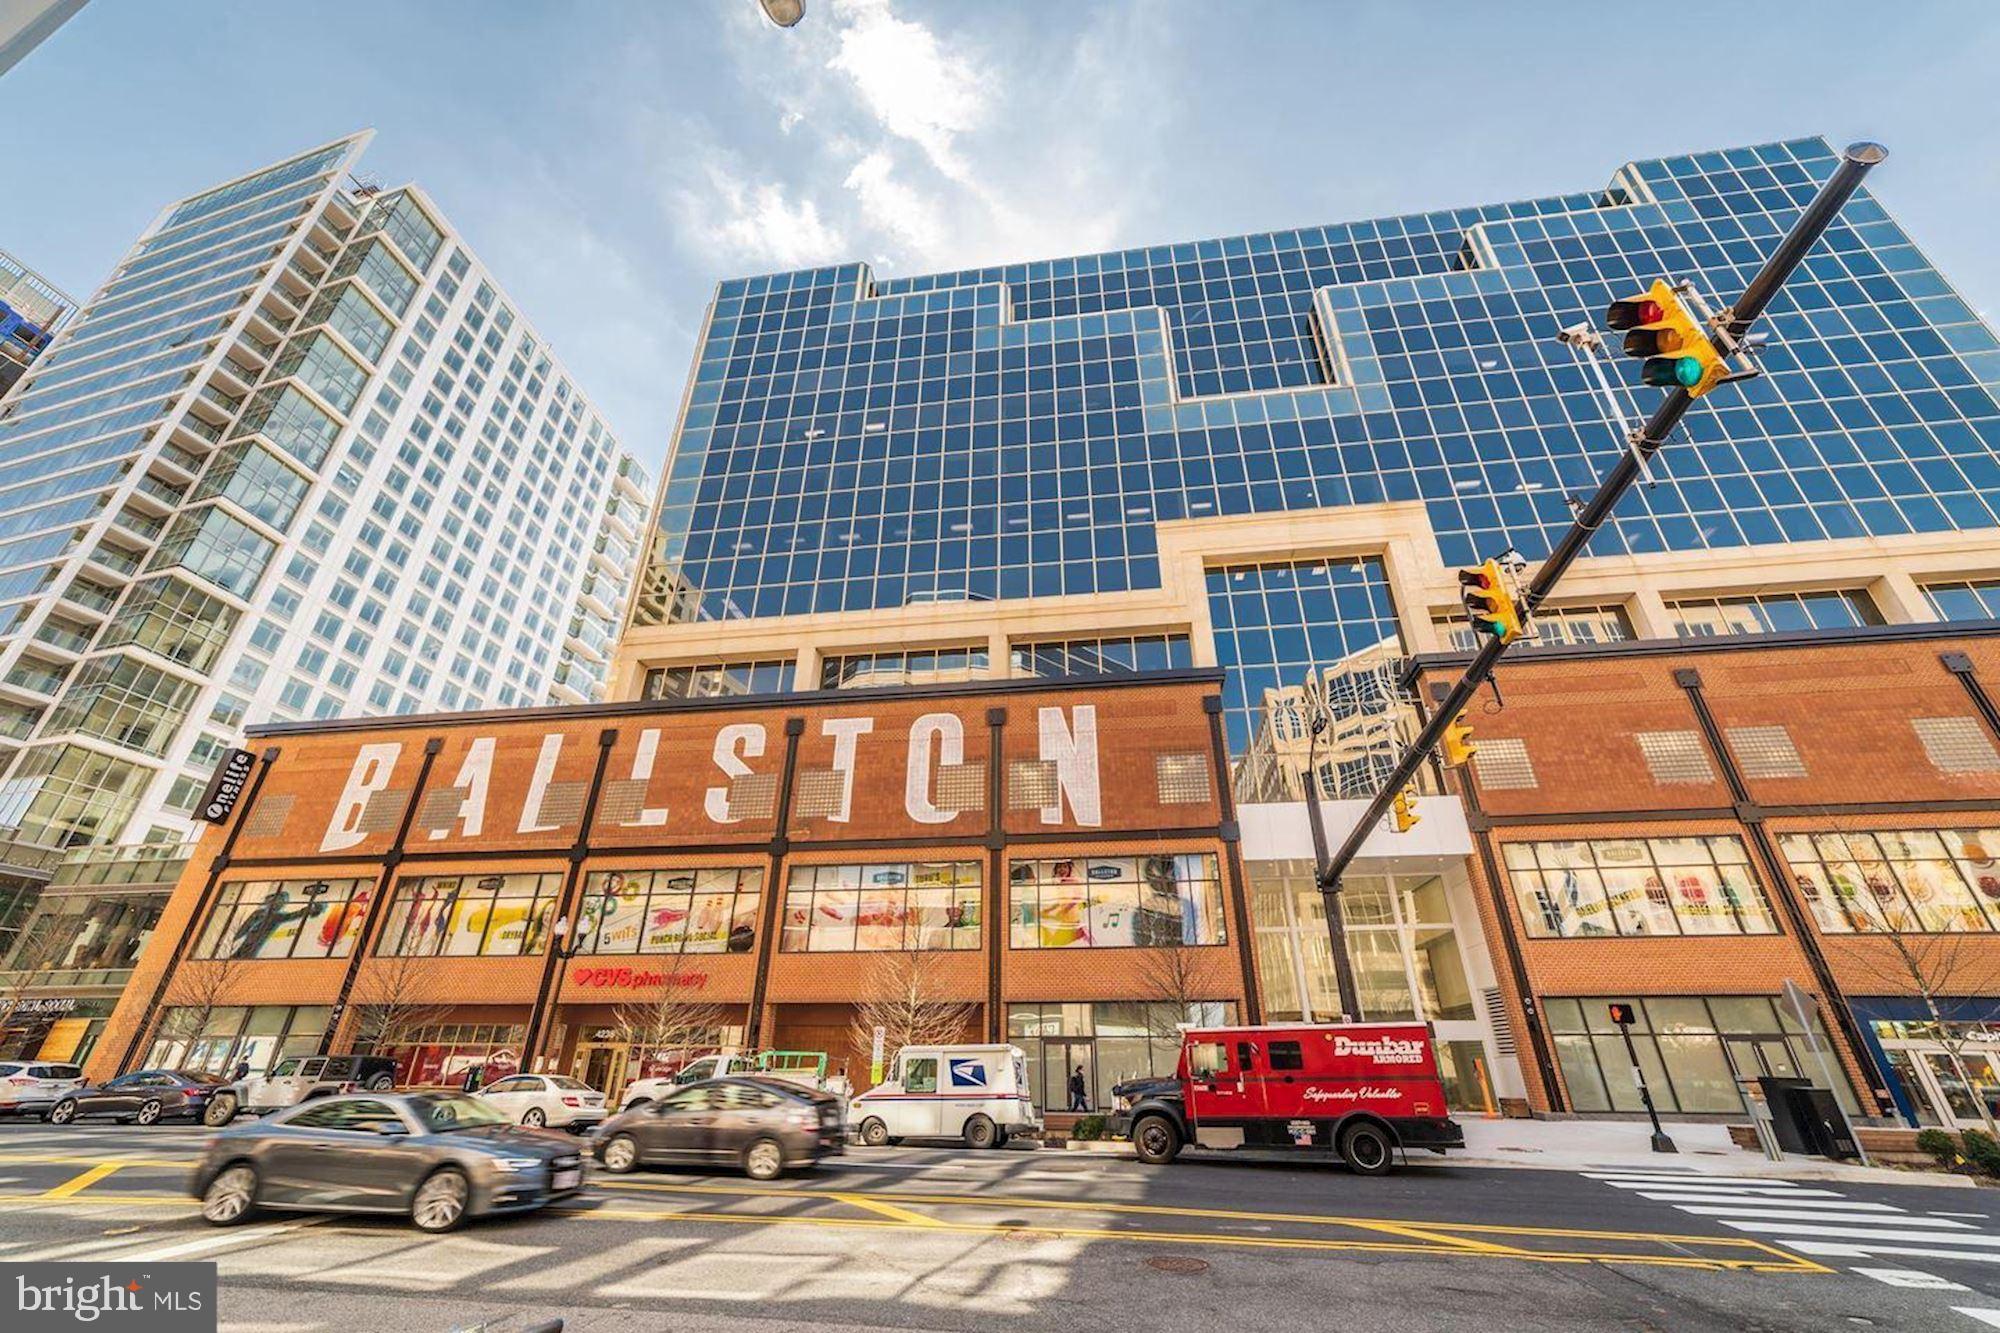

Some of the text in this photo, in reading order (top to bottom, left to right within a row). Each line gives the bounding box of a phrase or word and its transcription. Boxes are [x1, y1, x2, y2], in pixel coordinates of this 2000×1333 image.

[319, 704, 1101, 852] BALLSTON
[604, 932, 611, 944] 5
[595, 966, 632, 987] CVS
[1334, 1036, 1425, 1056] Dunbar
[1373, 1054, 1423, 1064] ARMORED
[1303, 1086, 1402, 1102] Safeguarding Valuables
